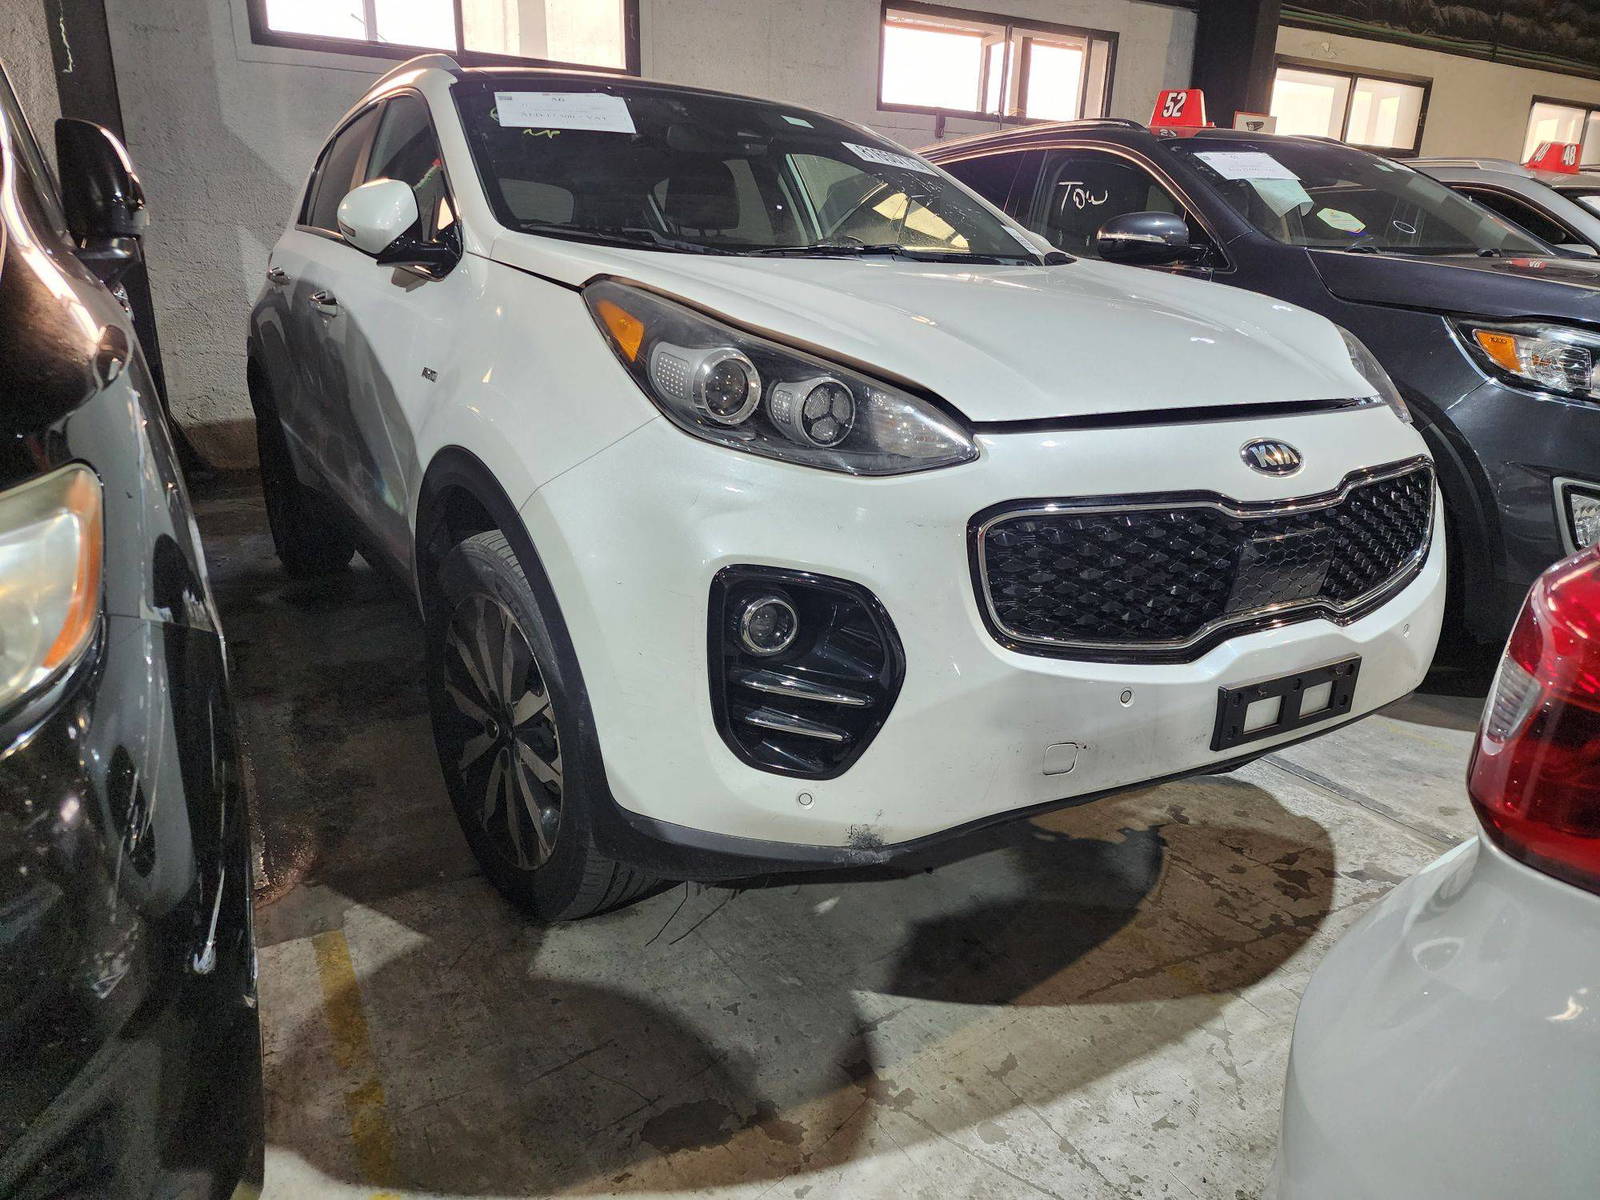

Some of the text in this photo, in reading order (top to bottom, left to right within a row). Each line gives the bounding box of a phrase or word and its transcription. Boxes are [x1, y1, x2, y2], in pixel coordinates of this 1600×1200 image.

[1162, 92, 1187, 118] 52
[1563, 144, 1577, 166] 48
[1249, 444, 1300, 468] KIA
